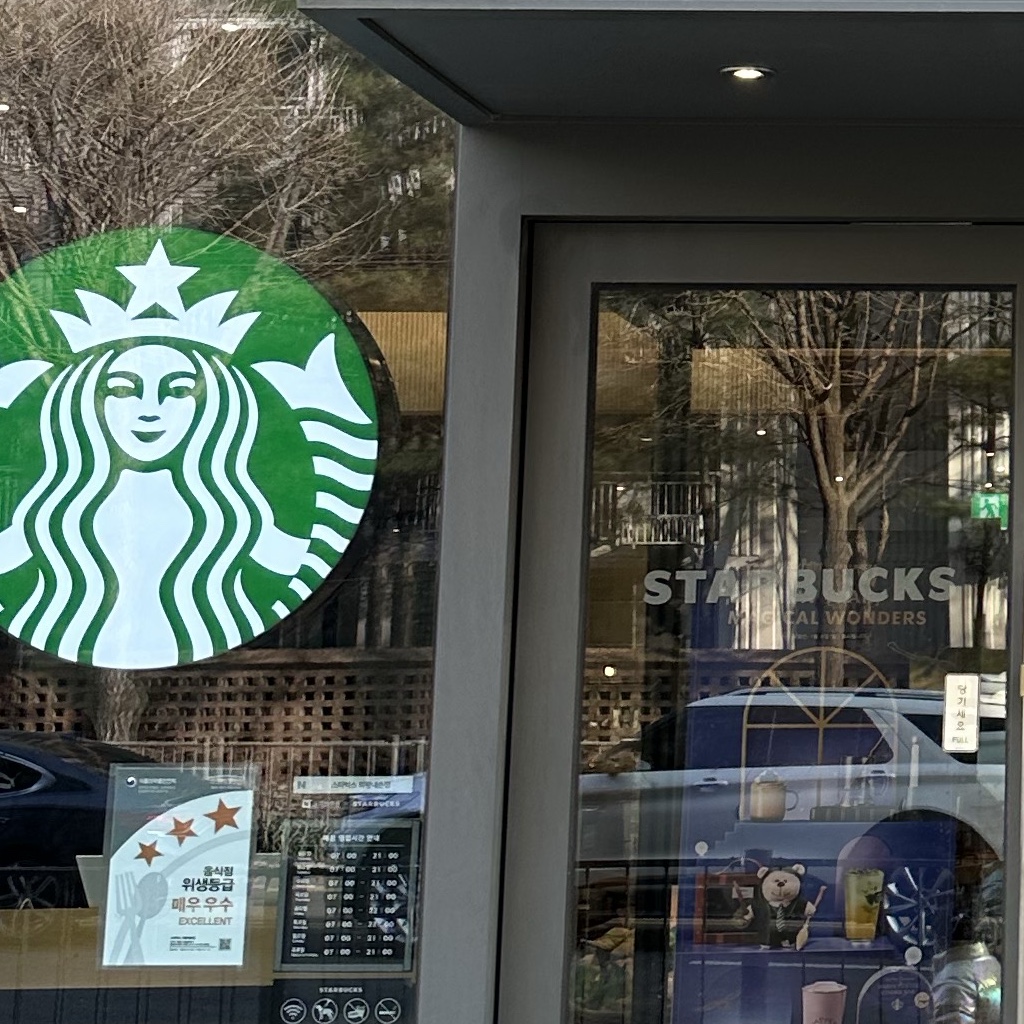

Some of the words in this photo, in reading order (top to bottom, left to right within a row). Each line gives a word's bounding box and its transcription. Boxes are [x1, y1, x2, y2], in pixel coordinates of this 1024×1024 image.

[826, 610, 927, 626] WONDERS
[956, 684, 967, 731] 당기세요
[203, 865, 234, 876] 음식점
[182, 878, 235, 892] 위생등급
[178, 916, 233, 925] EXCELLENT
[319, 986, 363, 994] STARBUCKS
